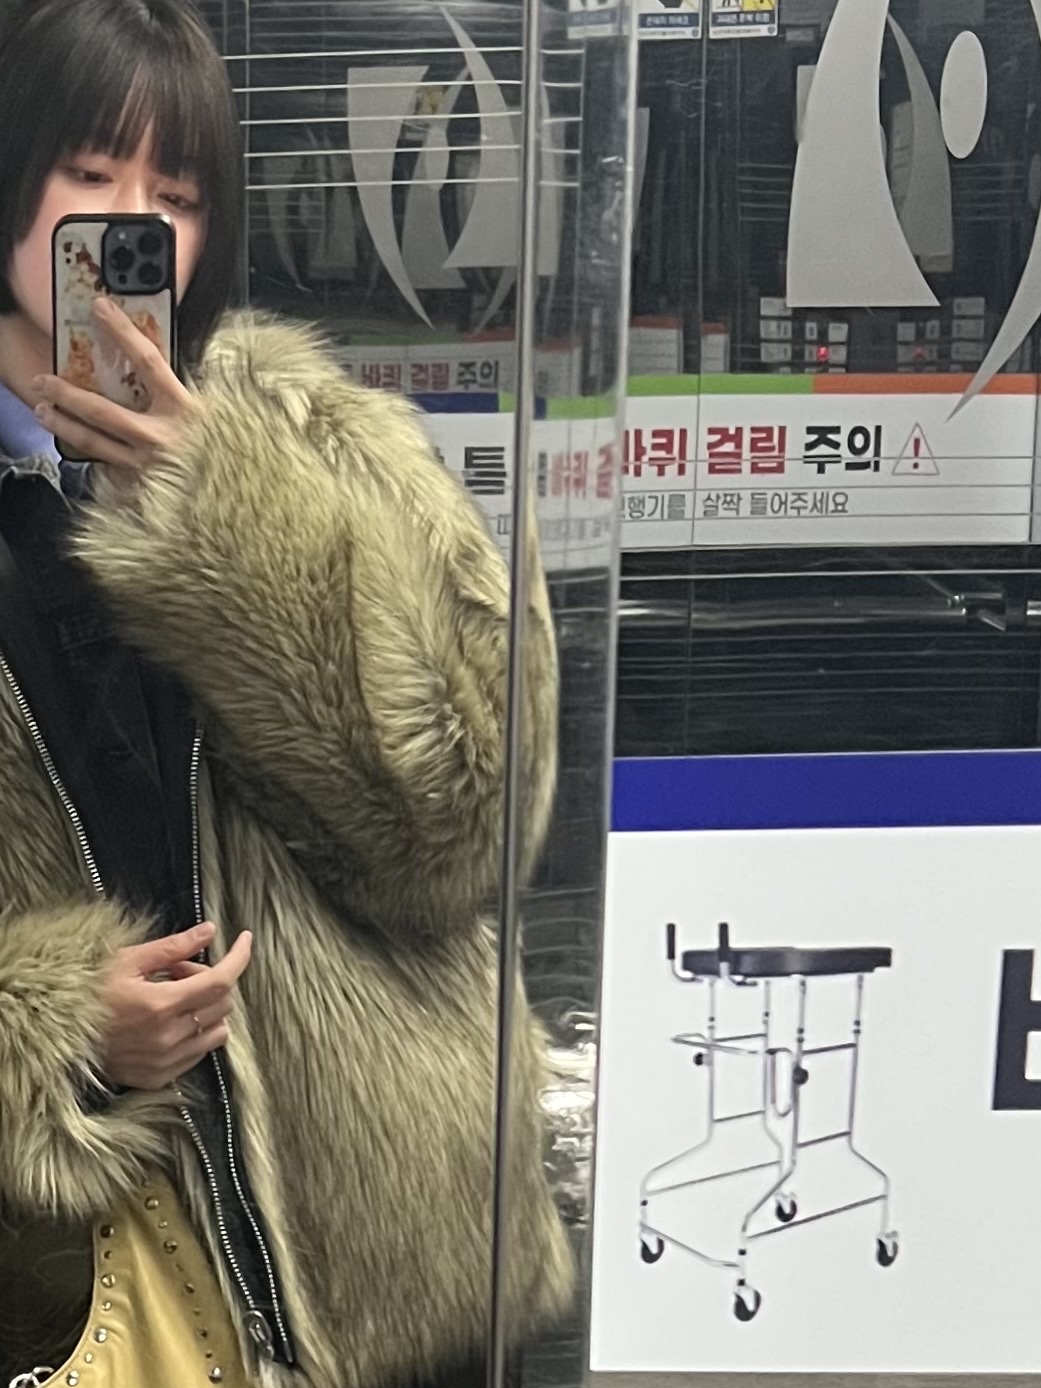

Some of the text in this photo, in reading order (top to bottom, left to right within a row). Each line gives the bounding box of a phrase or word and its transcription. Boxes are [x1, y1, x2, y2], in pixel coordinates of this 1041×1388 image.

[458, 360, 499, 391] 주의
[707, 425, 787, 475] 걸림
[802, 424, 883, 474] 주의
[620, 491, 849, 520] 행기를 살짝 들어주세요
